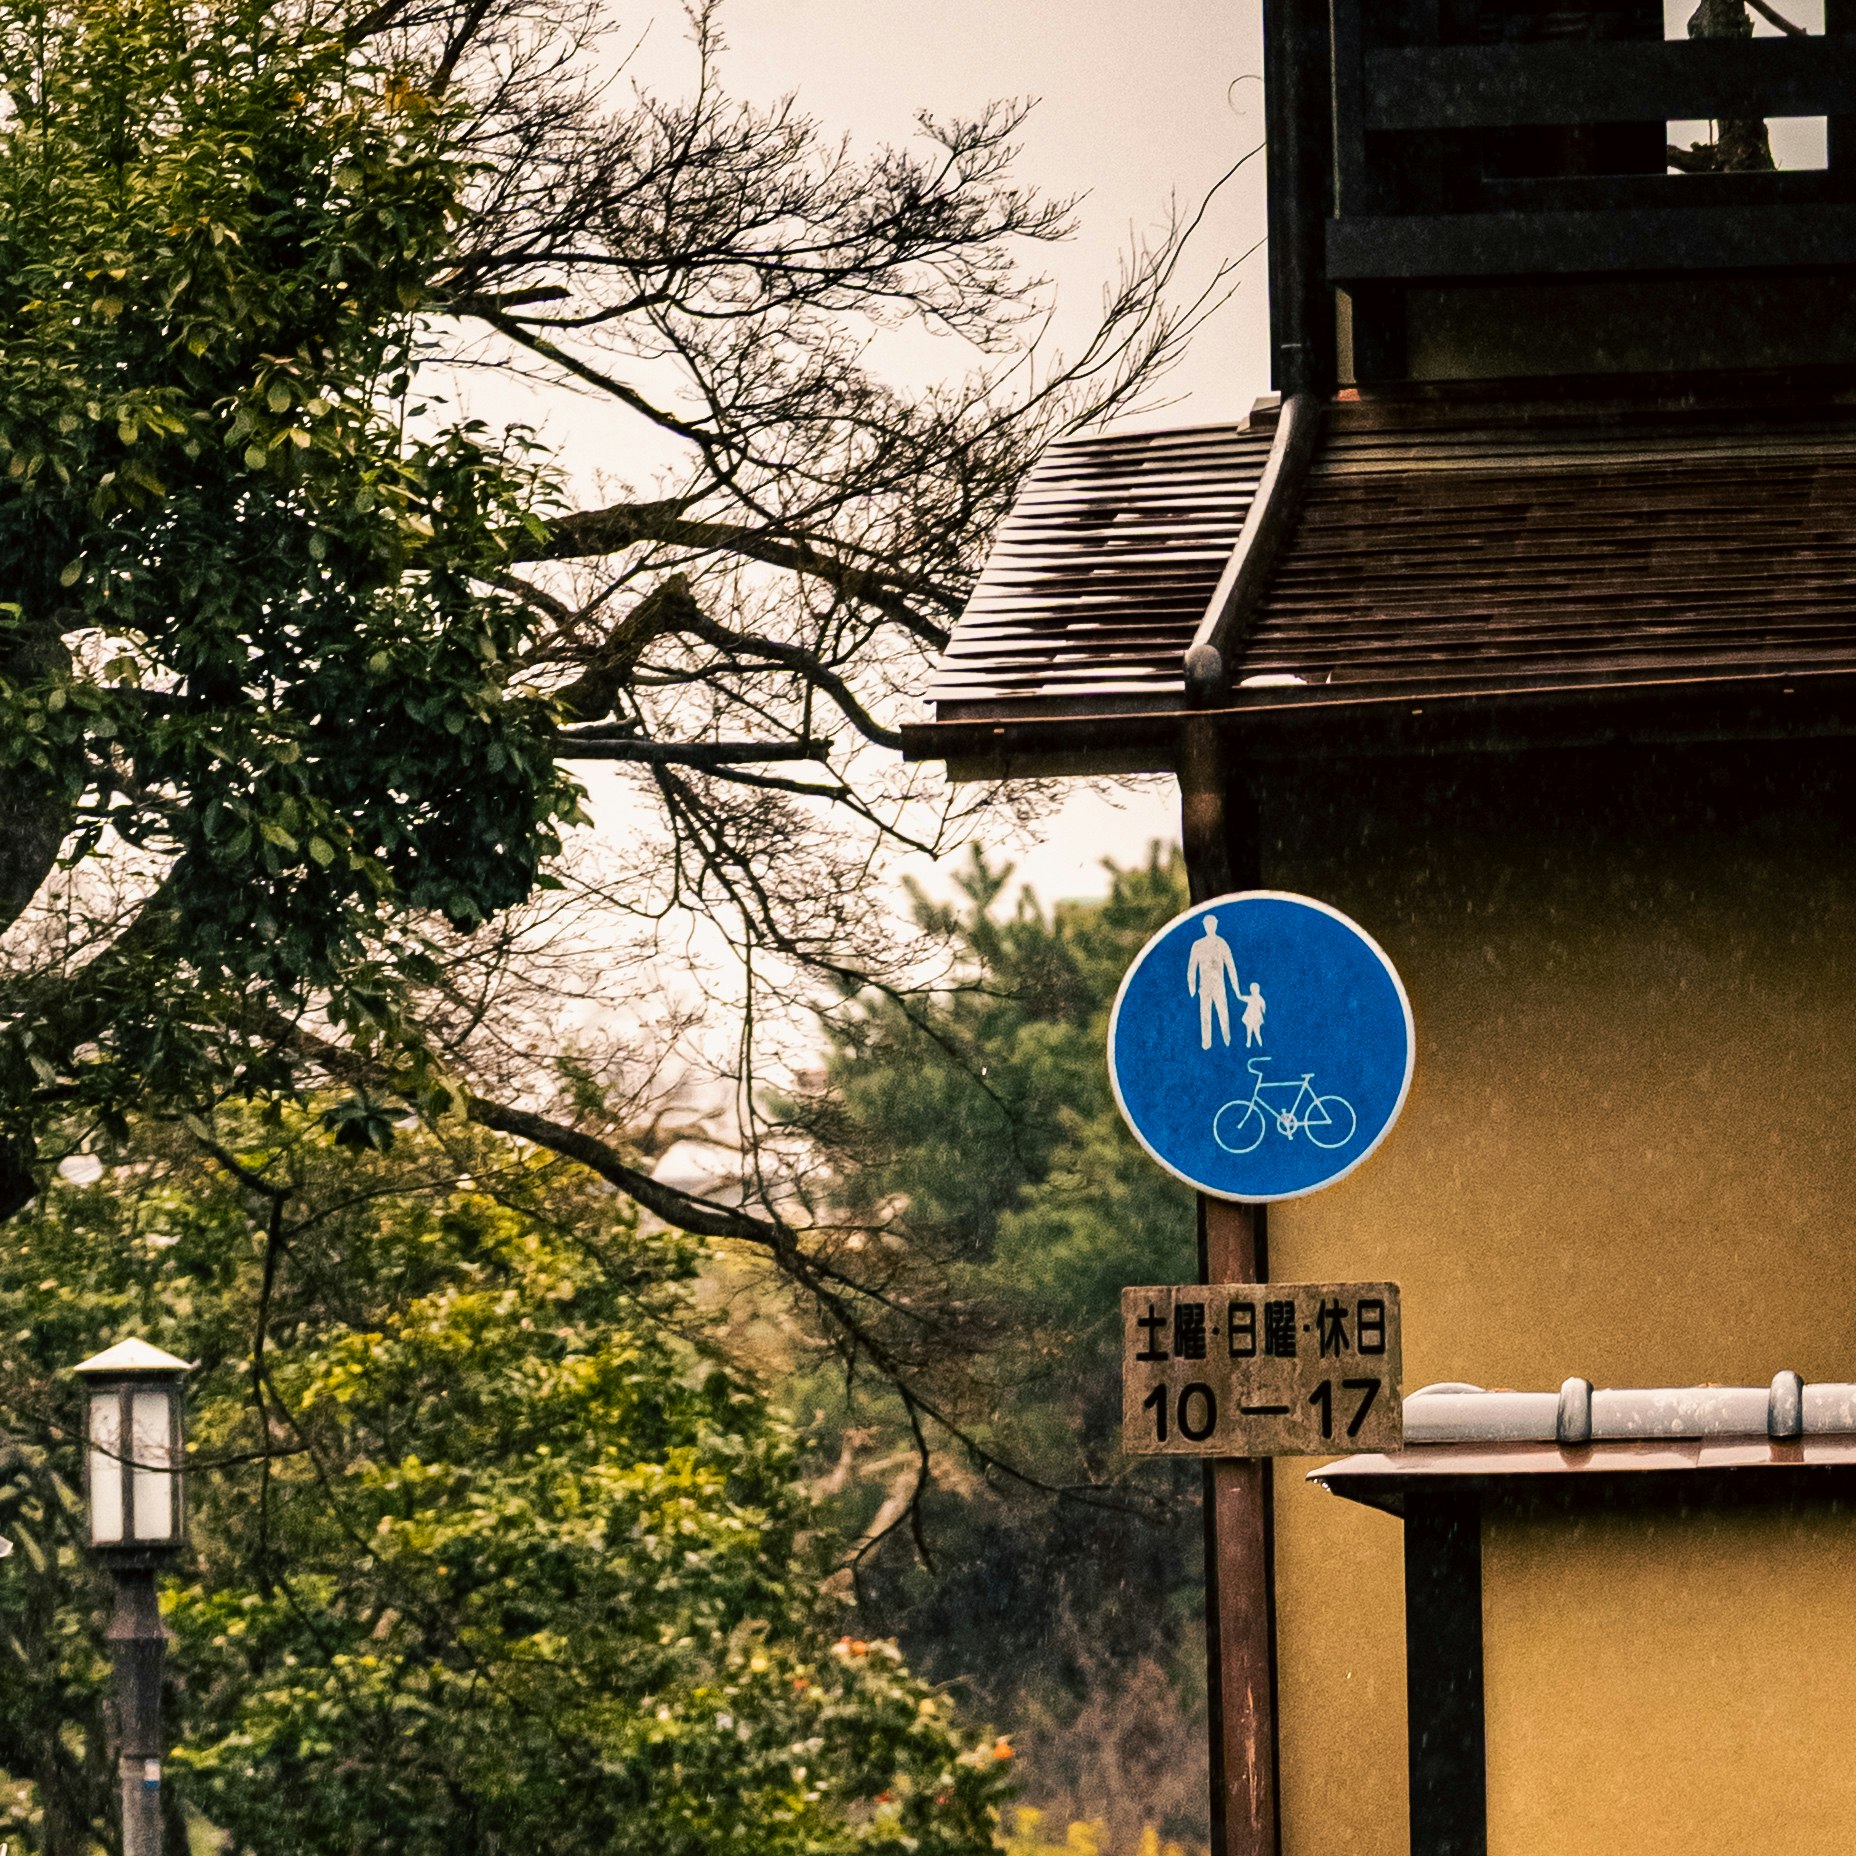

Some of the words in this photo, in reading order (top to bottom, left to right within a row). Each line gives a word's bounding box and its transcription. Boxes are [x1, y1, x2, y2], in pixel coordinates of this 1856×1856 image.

[1136, 1298, 1386, 1361] 土曜・日曜・休日
